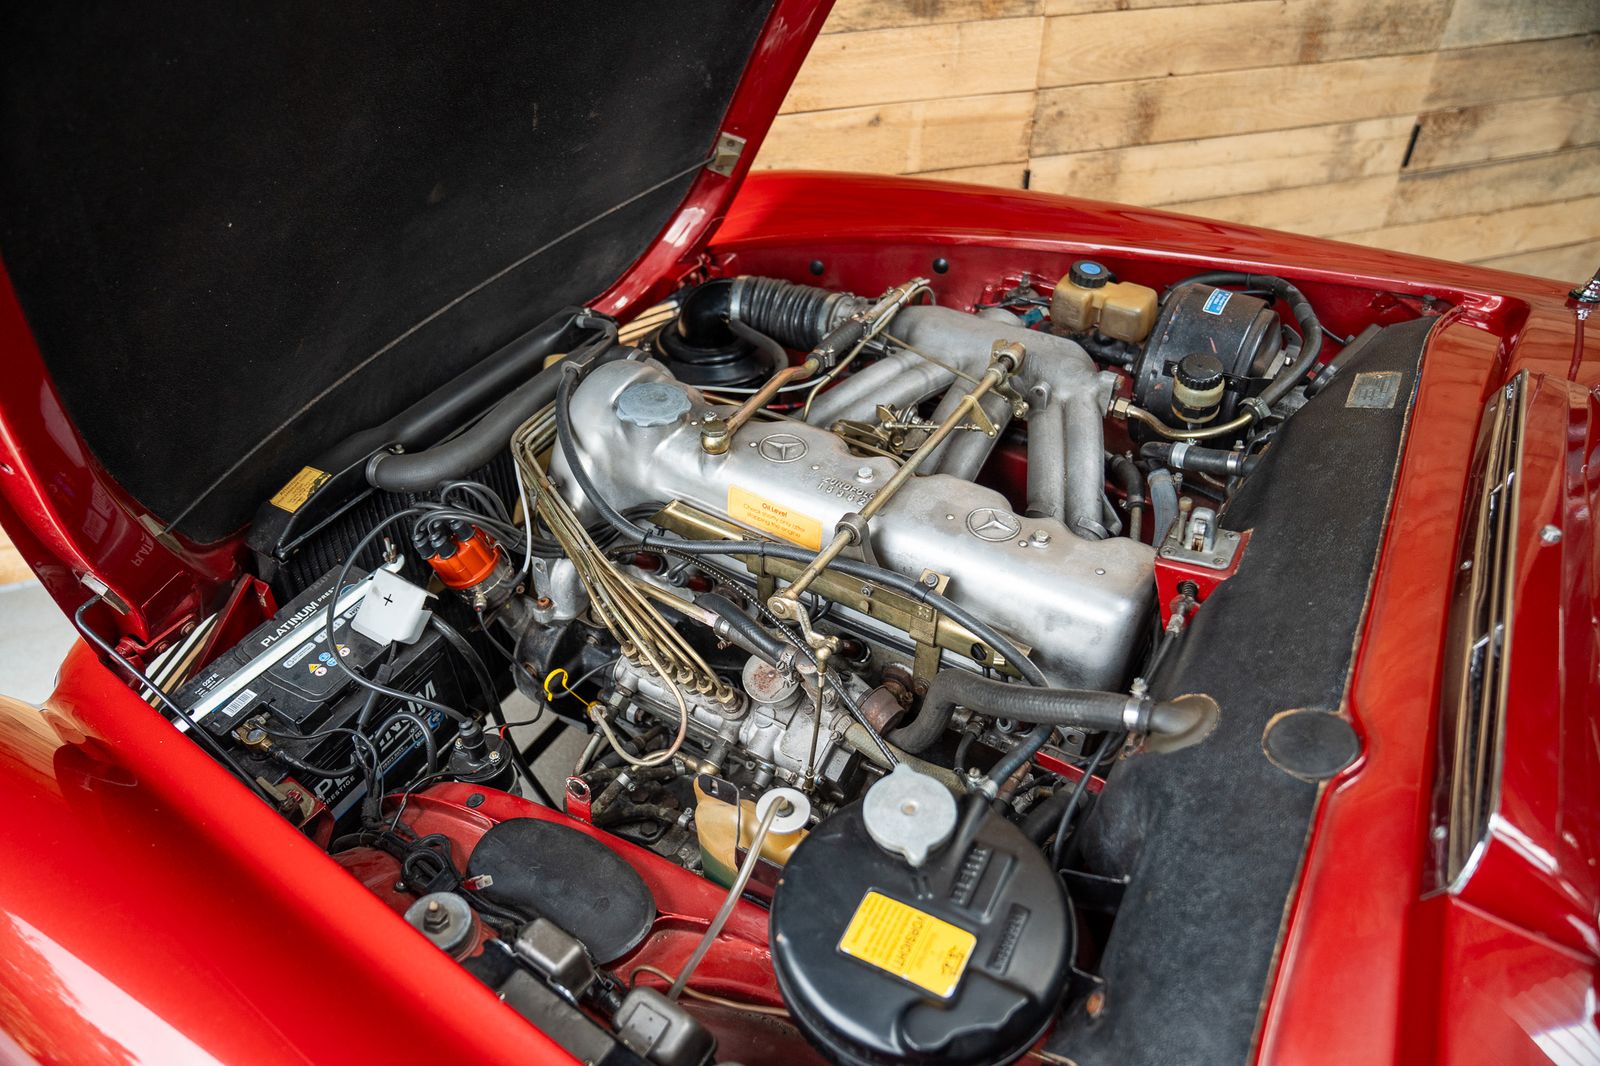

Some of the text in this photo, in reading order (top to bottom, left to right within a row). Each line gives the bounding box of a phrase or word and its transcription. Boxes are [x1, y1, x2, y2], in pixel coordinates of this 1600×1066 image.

[762, 502, 787, 517] Oil Level
[260, 600, 319, 647] PLATINUM
